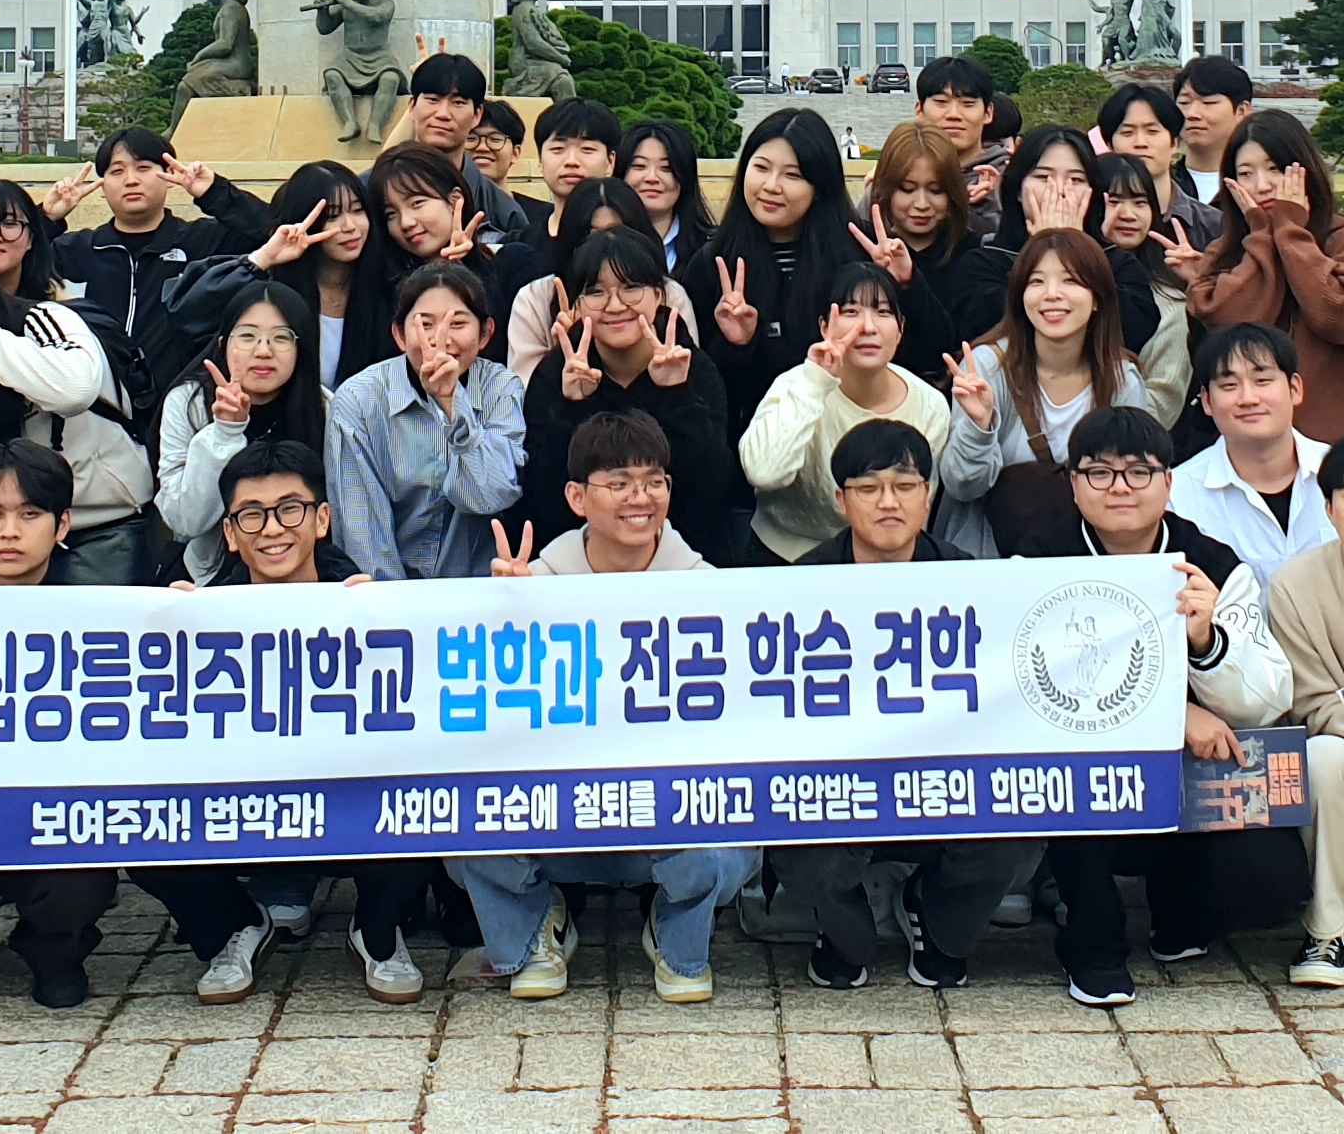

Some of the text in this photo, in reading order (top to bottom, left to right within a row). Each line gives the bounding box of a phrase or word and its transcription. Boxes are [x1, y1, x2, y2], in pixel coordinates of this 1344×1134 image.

[437, 619, 603, 733] 법학과
[621, 616, 726, 723] 전공
[746, 610, 852, 718] 학습
[874, 606, 981, 714] 견학
[1082, 585, 1145, 621] NATIONAL
[1137, 619, 1160, 703] UNIVERSITY
[31, 793, 324, 845] 보여주자! 법학과!
[376, 764, 1144, 835] 사회의 모순에 철퇴를 가하고 억압받는 민중의 희망이 되자
